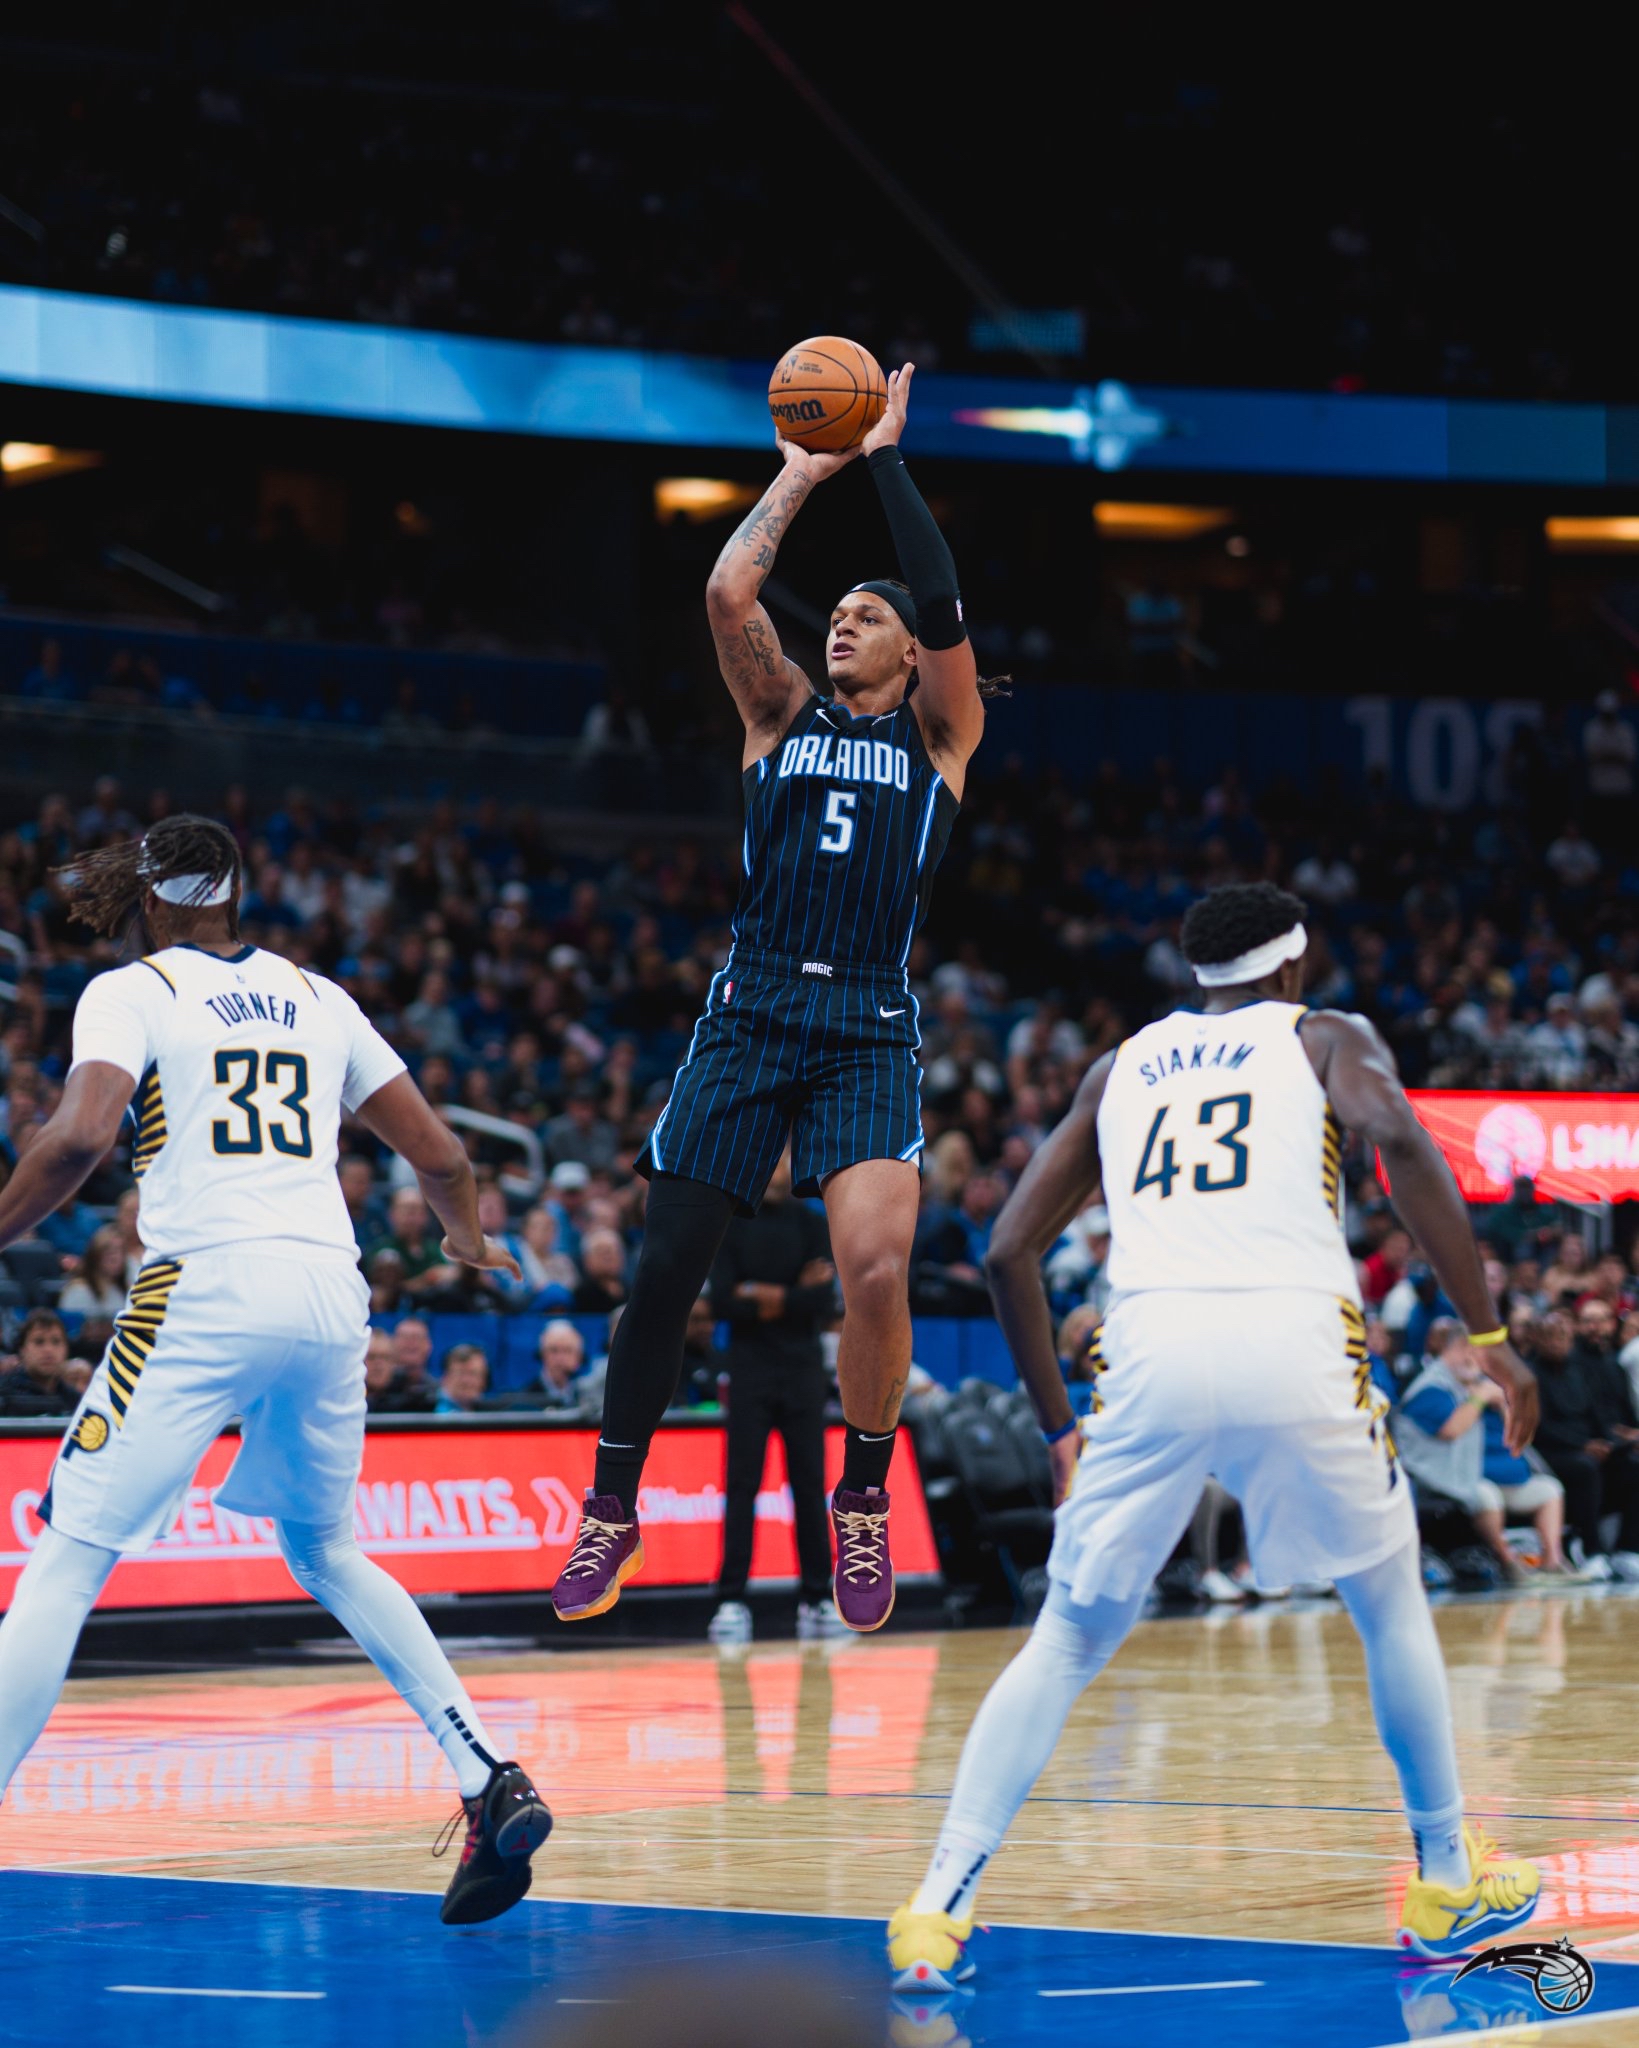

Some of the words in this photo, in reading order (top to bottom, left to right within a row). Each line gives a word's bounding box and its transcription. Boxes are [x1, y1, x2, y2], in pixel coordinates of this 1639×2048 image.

[778, 735, 910, 792] ORLANDO
[820, 789, 857, 853] 5
[801, 962, 833, 977] MAGIC
[205, 991, 297, 1030] TURNER
[1139, 1042, 1256, 1086] SIAKAM
[211, 1048, 313, 1159] 33
[1131, 1091, 1252, 1201] 43
[353, 1476, 538, 1540] WAITS.
